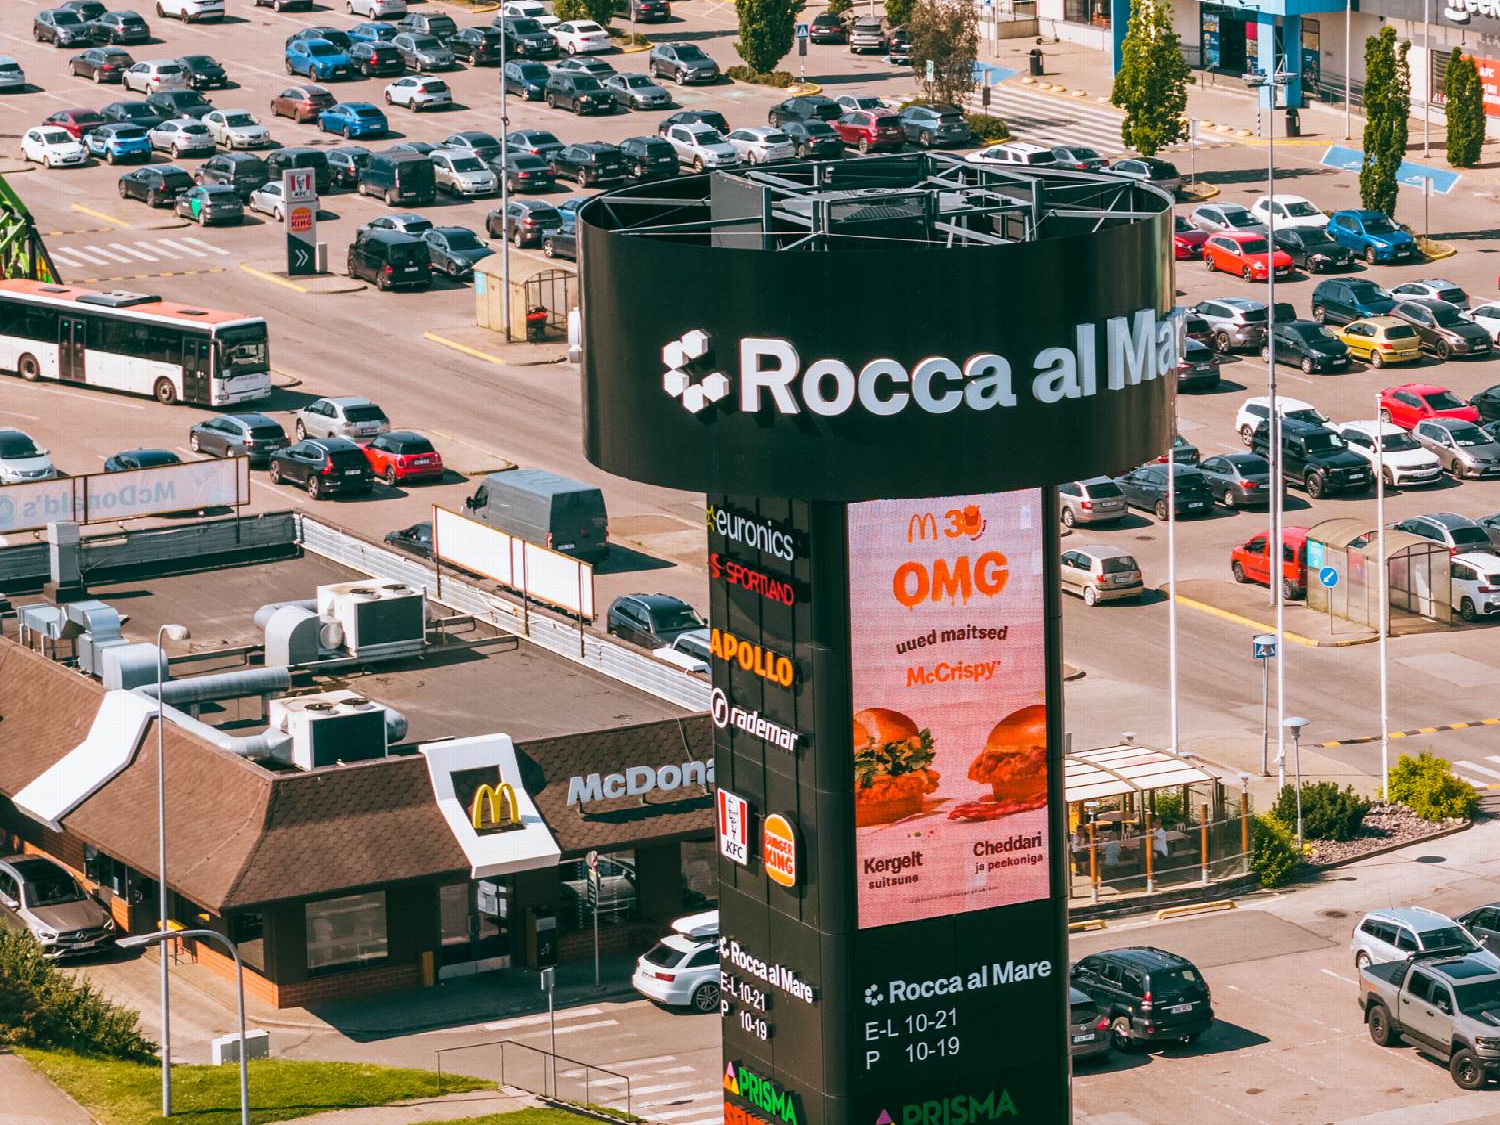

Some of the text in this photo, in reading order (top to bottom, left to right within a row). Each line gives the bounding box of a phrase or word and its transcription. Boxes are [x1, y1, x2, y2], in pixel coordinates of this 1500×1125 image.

[740, 336, 1017, 417] Rocca
[1032, 322, 1097, 404] al
[716, 509, 794, 561] euronics
[725, 561, 795, 606] SPORTLAND
[892, 550, 1009, 610] OMG
[896, 623, 1009, 655] uued maitsed
[709, 628, 795, 688] APOLLO
[906, 660, 998, 688] McCrispy
[729, 707, 799, 752] rademar
[725, 840, 743, 860] KFC
[764, 846, 794, 875] KING
[765, 835, 793, 856] BURGER
[972, 830, 1043, 857] Cheddari
[864, 850, 924, 875] Kergelt
[975, 853, 1044, 875] ja peekoniga
[868, 874, 919, 890] suitsune
[730, 940, 814, 1004] Rocca al Mare
[889, 959, 1052, 1004] Rocca al Mare
[720, 970, 766, 1012] E-L 10-21
[720, 999, 768, 1041] P 10-19
[865, 1007, 958, 1041] E-L 10-21
[866, 1036, 960, 1070] P 10-19
[738, 1066, 799, 1125] PRISMA
[902, 1088, 1019, 1125] PRISMA
